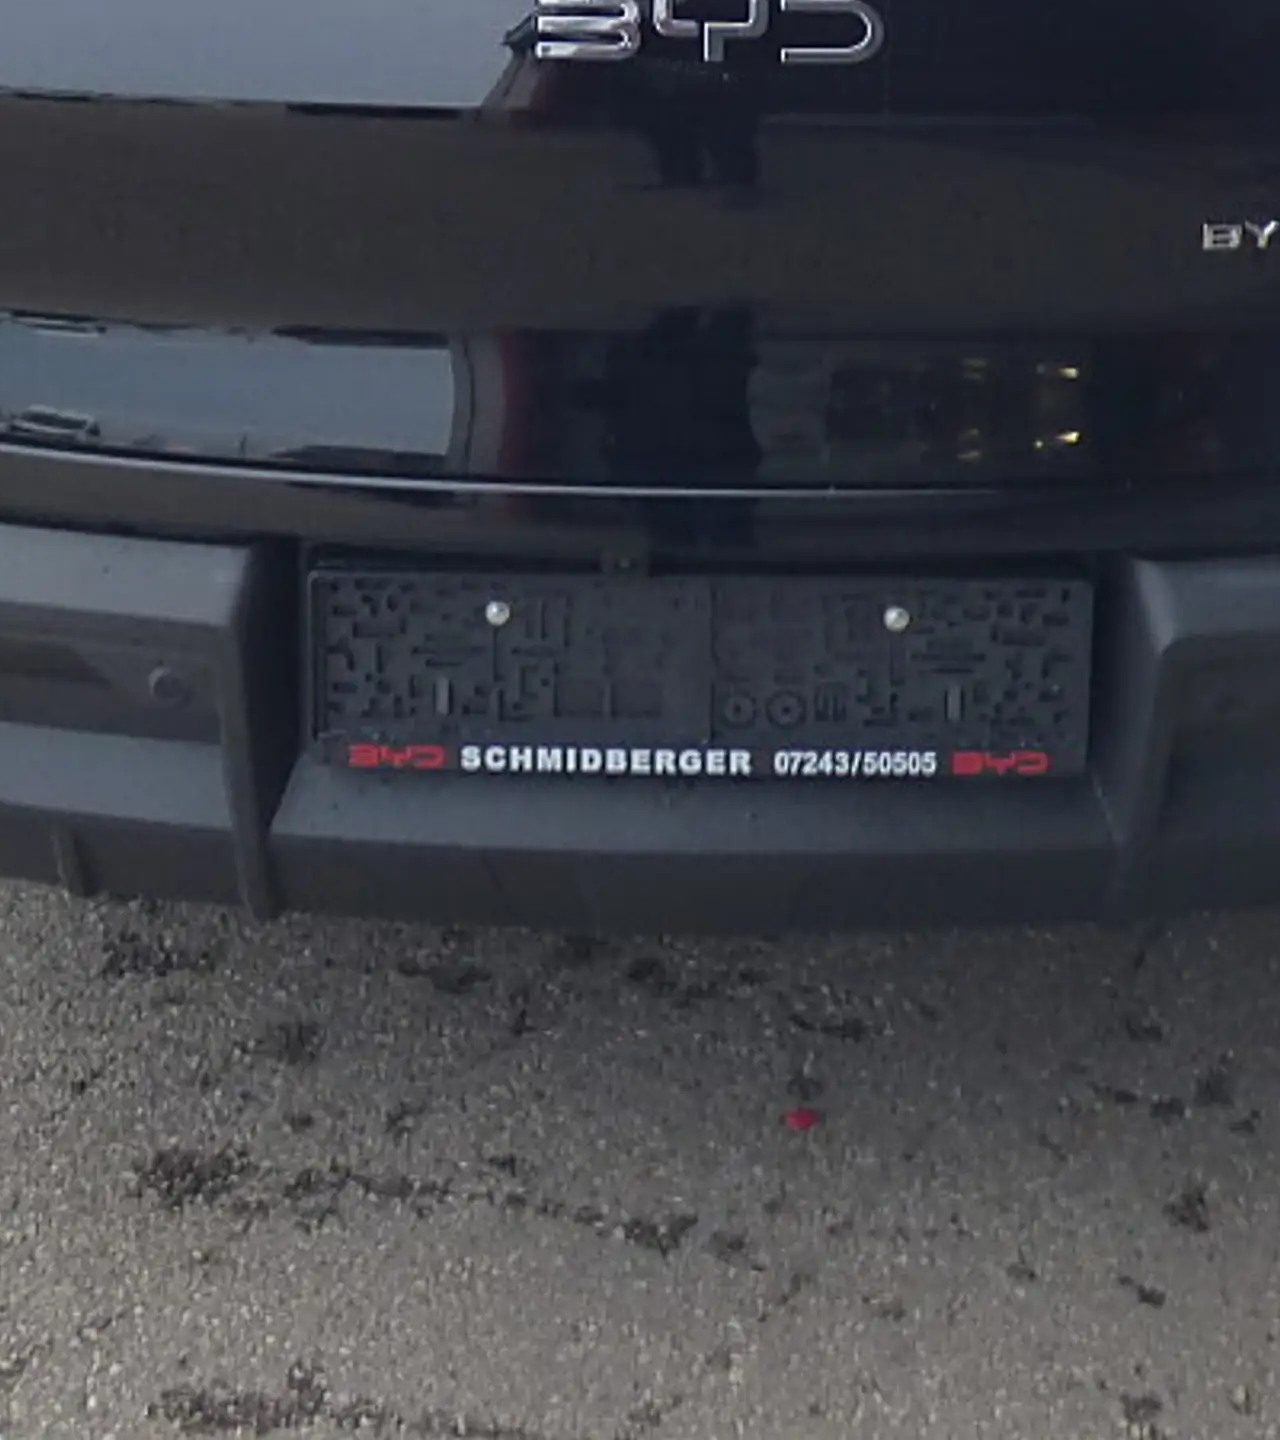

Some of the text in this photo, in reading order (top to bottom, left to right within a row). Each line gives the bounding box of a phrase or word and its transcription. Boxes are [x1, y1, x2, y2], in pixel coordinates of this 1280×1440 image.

[349, 745, 1049, 777] BYD SCHMIDBERGER 07243/50505 BYD
